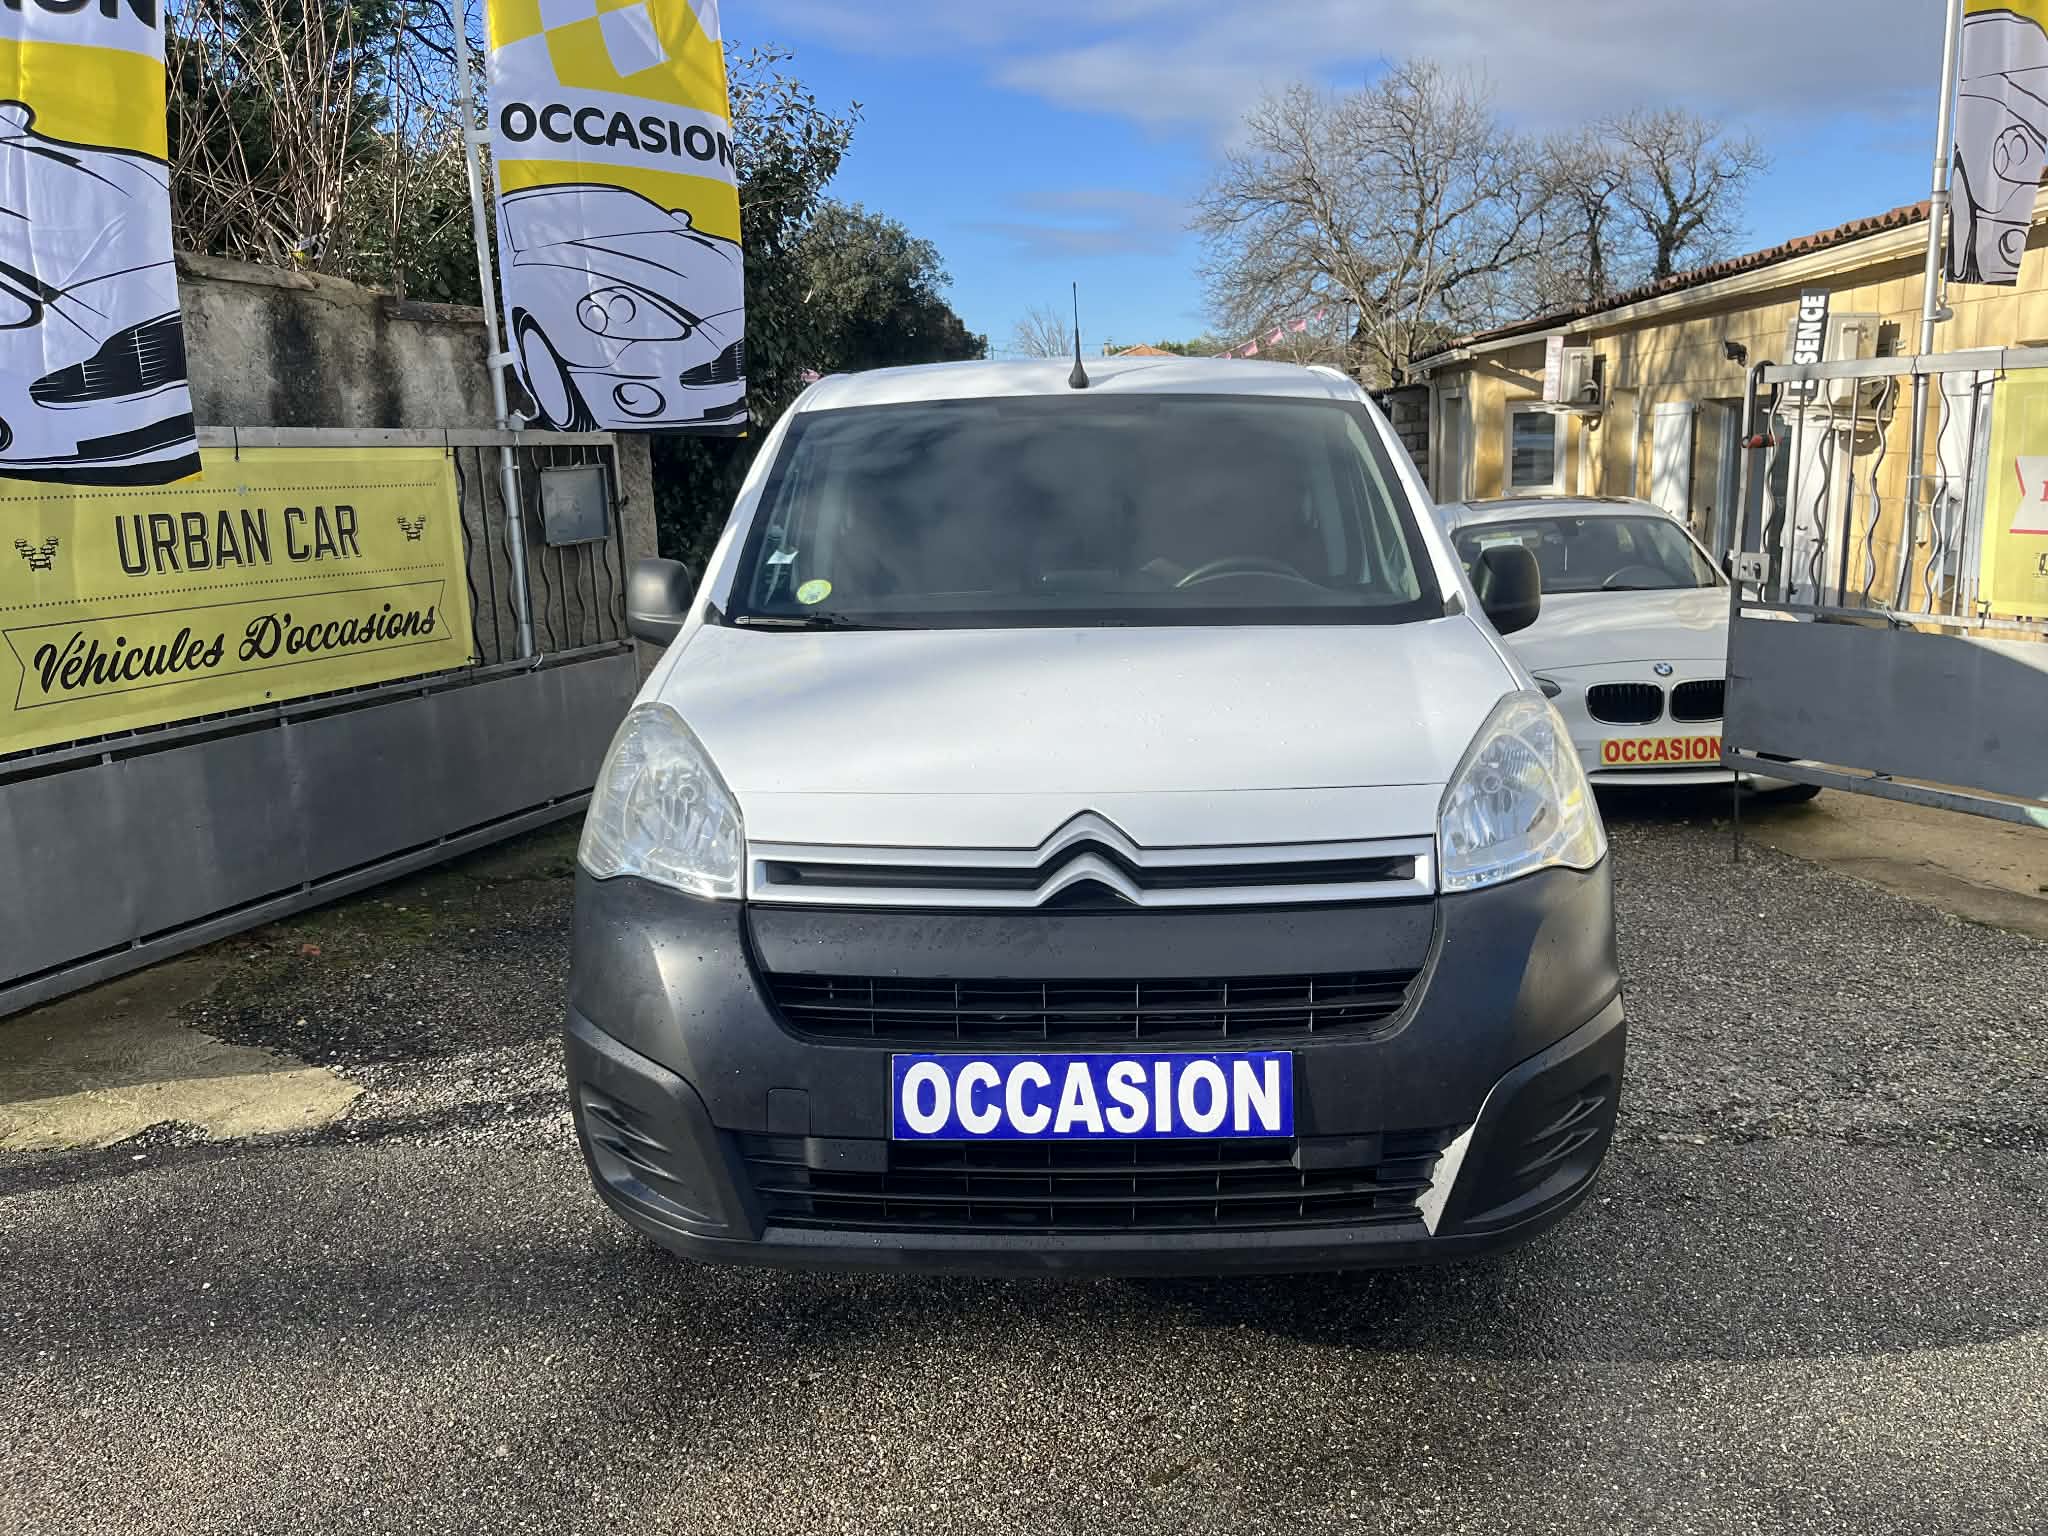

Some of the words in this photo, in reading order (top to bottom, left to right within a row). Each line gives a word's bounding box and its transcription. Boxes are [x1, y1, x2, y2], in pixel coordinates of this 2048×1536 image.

[1790, 295, 1826, 390] ESENCE
[115, 507, 272, 577] URBAN
[283, 504, 362, 563] CAR
[33, 627, 225, 694] Véhicules
[238, 602, 436, 662] D'occasions
[1604, 736, 1723, 763] OCCASION
[901, 1059, 1282, 1135] OCCASION
